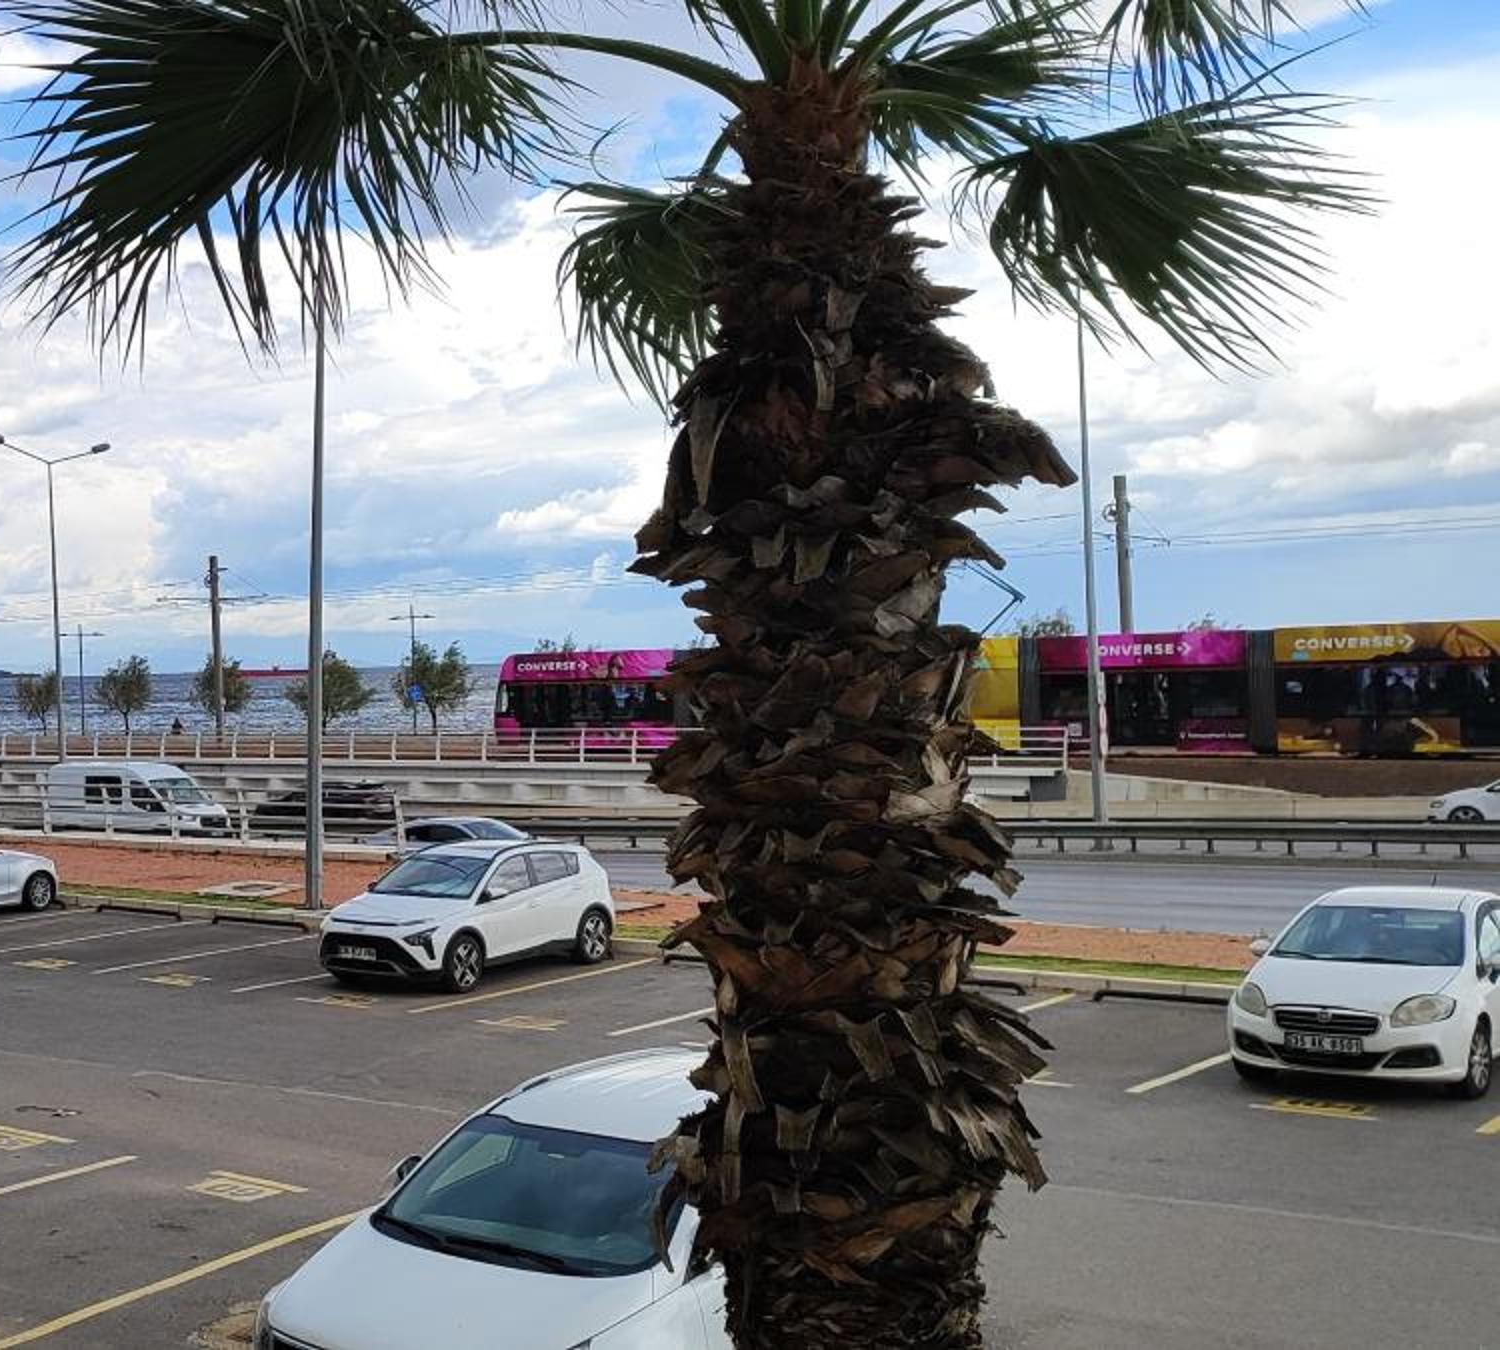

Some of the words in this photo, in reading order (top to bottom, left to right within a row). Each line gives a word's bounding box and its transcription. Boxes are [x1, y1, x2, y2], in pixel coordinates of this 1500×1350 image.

[1095, 643, 1174, 656] ONVERSE
[1294, 637, 1394, 651] CONVERSE
[517, 661, 576, 672] CONVERSE
